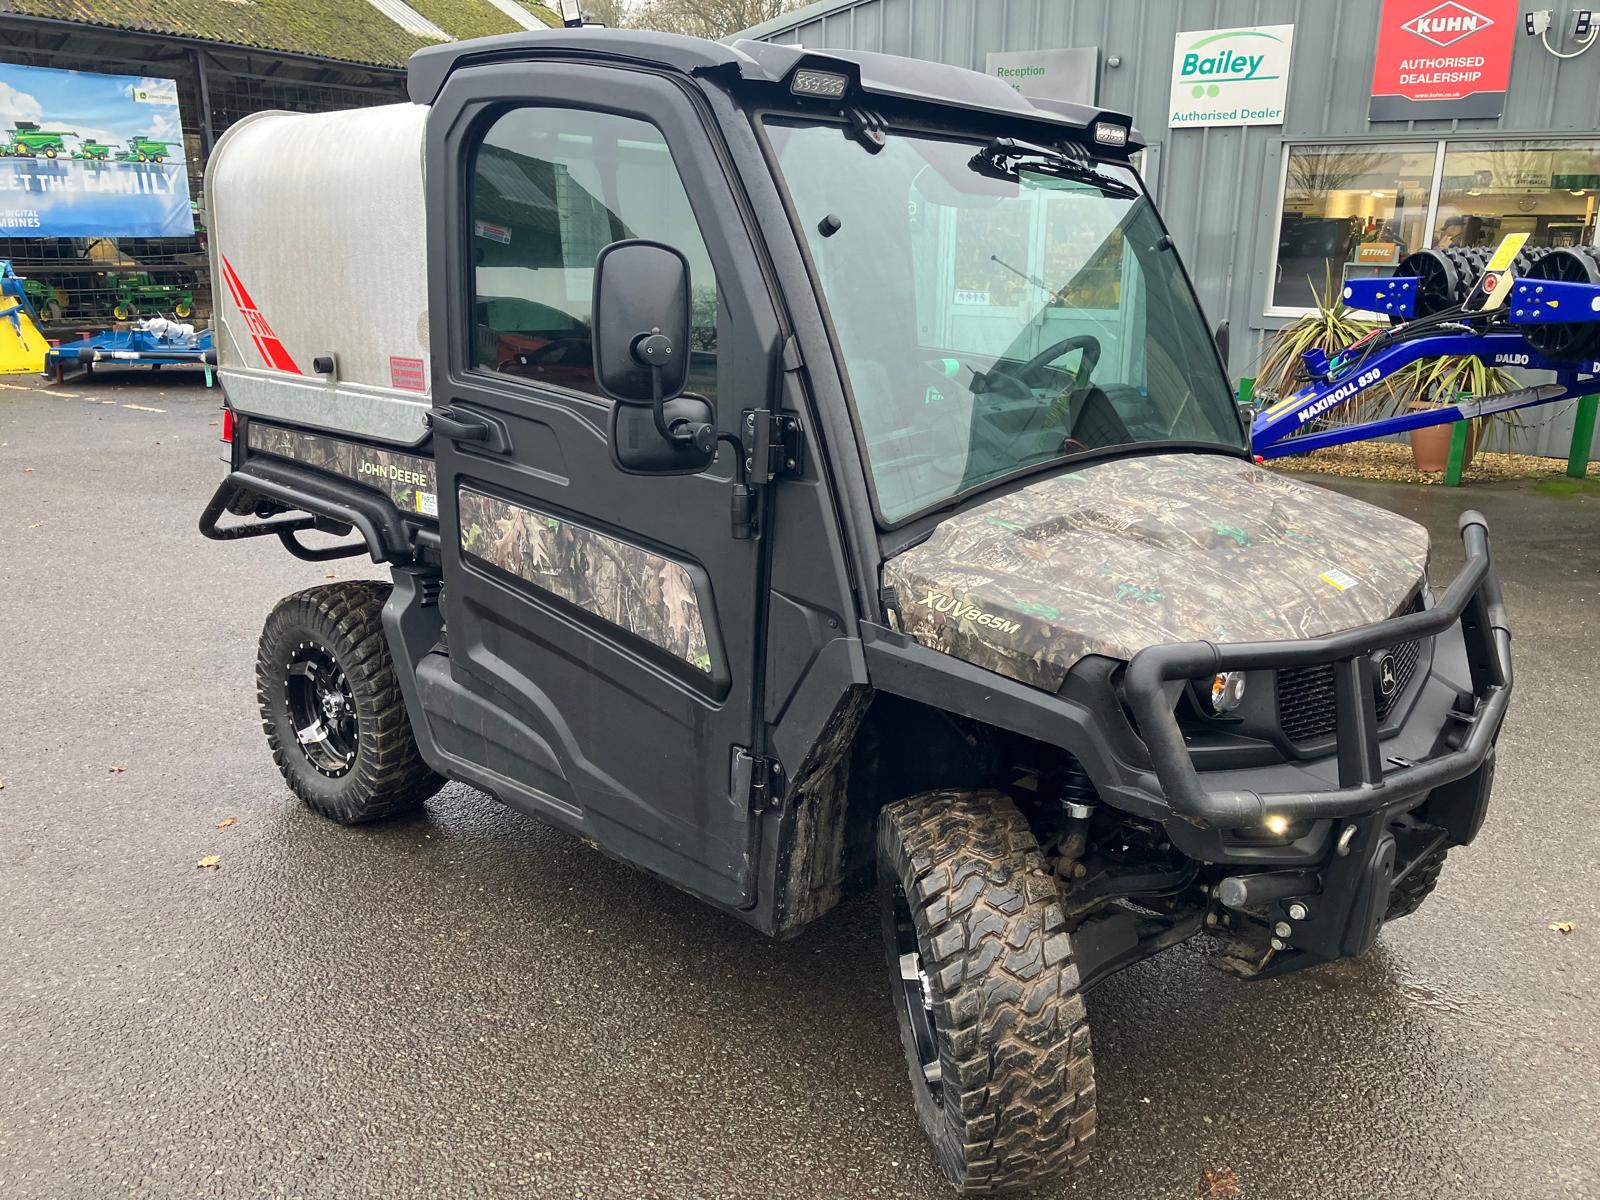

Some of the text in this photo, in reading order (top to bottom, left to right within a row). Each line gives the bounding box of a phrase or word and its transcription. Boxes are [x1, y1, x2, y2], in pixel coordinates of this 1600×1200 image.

[1417, 16, 1478, 33] KUHN
[1181, 50, 1264, 80] Bailey
[1400, 56, 1485, 70] AUTHORISED
[997, 65, 1046, 78] Reception
[1400, 71, 1482, 84] DEALERSHIP
[1172, 107, 1282, 121] Authorised Dealer
[36, 174, 75, 192] THE
[83, 170, 178, 195] FAMILY
[5, 209, 39, 218] DIGITAL
[1361, 248, 1391, 256] STIHL
[1495, 354, 1529, 365] DALBO
[1297, 368, 1381, 423] MAXIROLL 830
[358, 459, 427, 487] JOHN DEERE
[918, 590, 1021, 634] XUV865M
